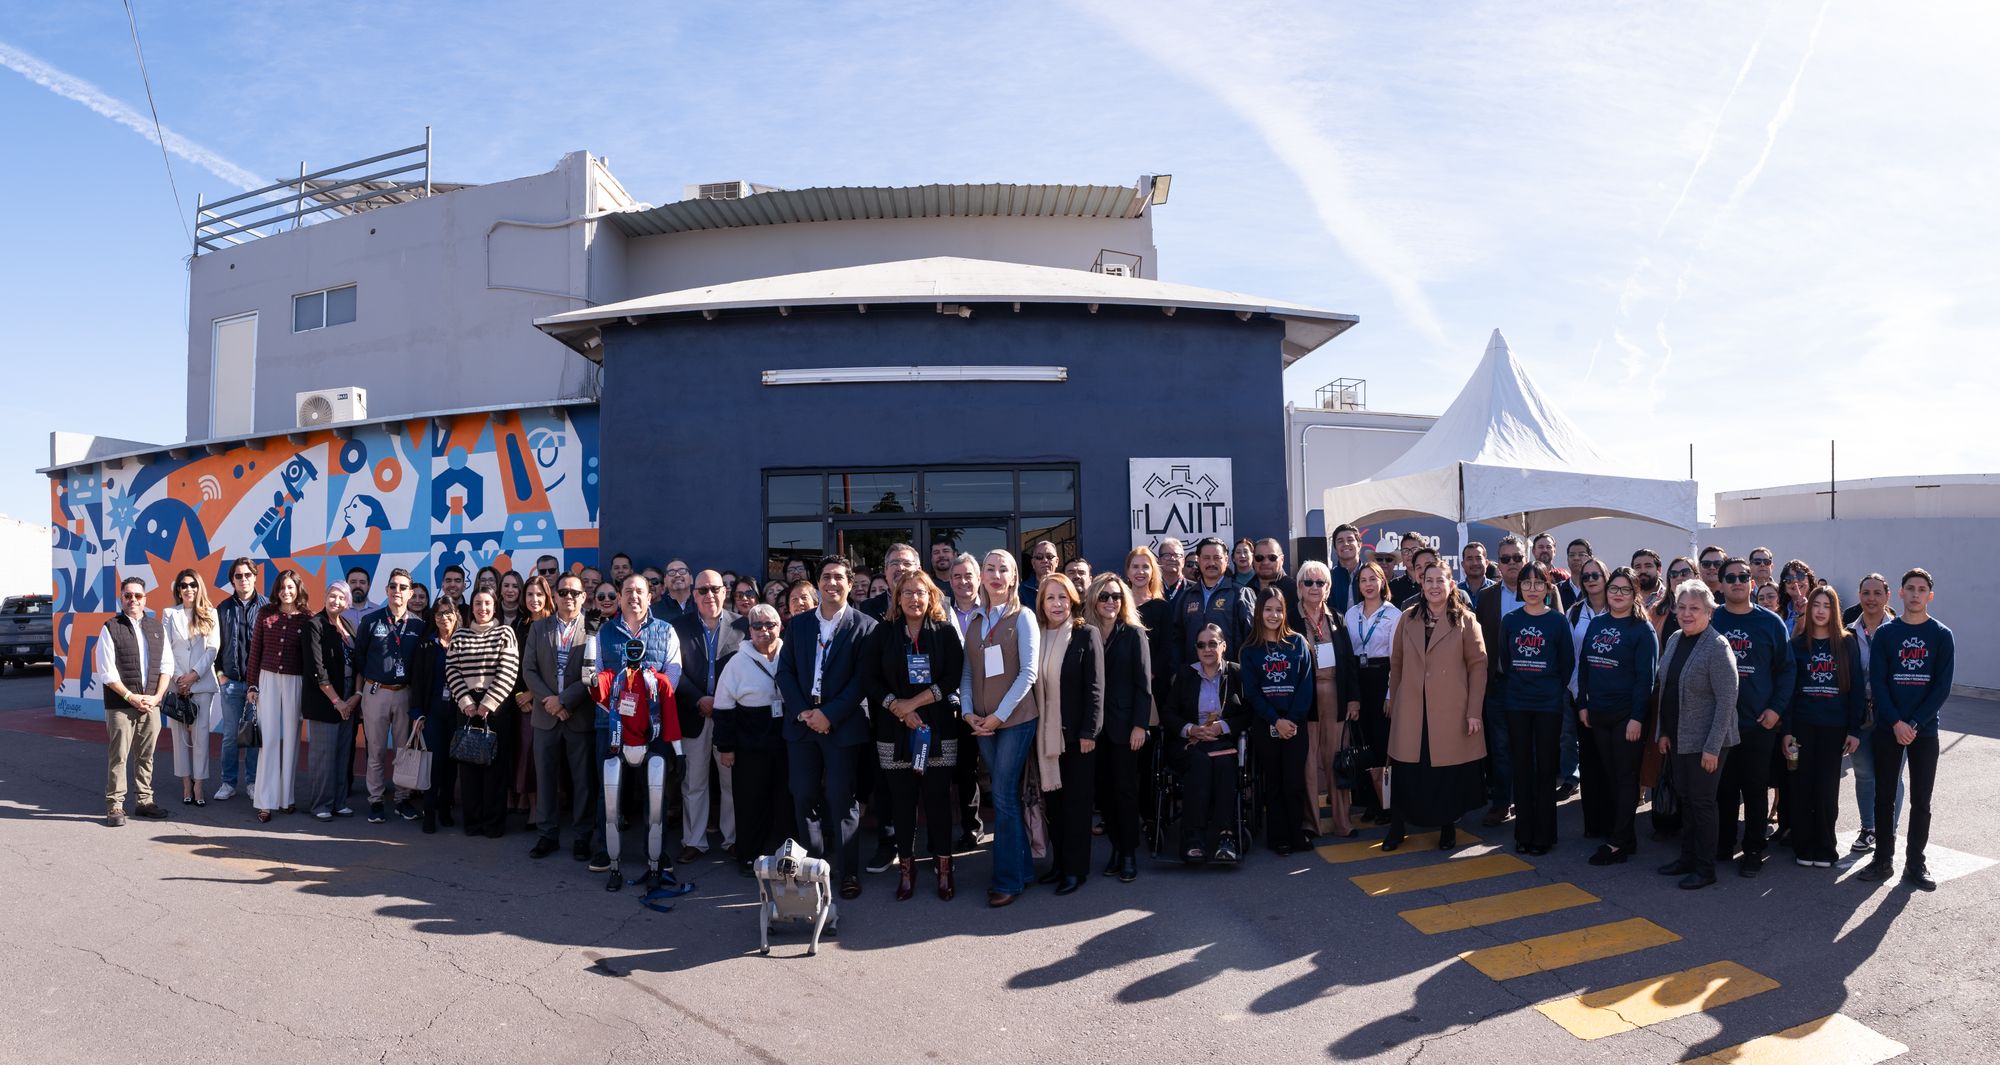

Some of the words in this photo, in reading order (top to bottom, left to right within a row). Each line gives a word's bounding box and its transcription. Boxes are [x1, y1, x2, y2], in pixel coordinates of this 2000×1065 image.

[1145, 502, 1225, 535] LAIIT
[1516, 635, 1544, 649] LAIIT
[1730, 639, 1751, 651] AIIT
[1901, 647, 1927, 660] LAIIT
[1264, 660, 1289, 673] LAIIT
